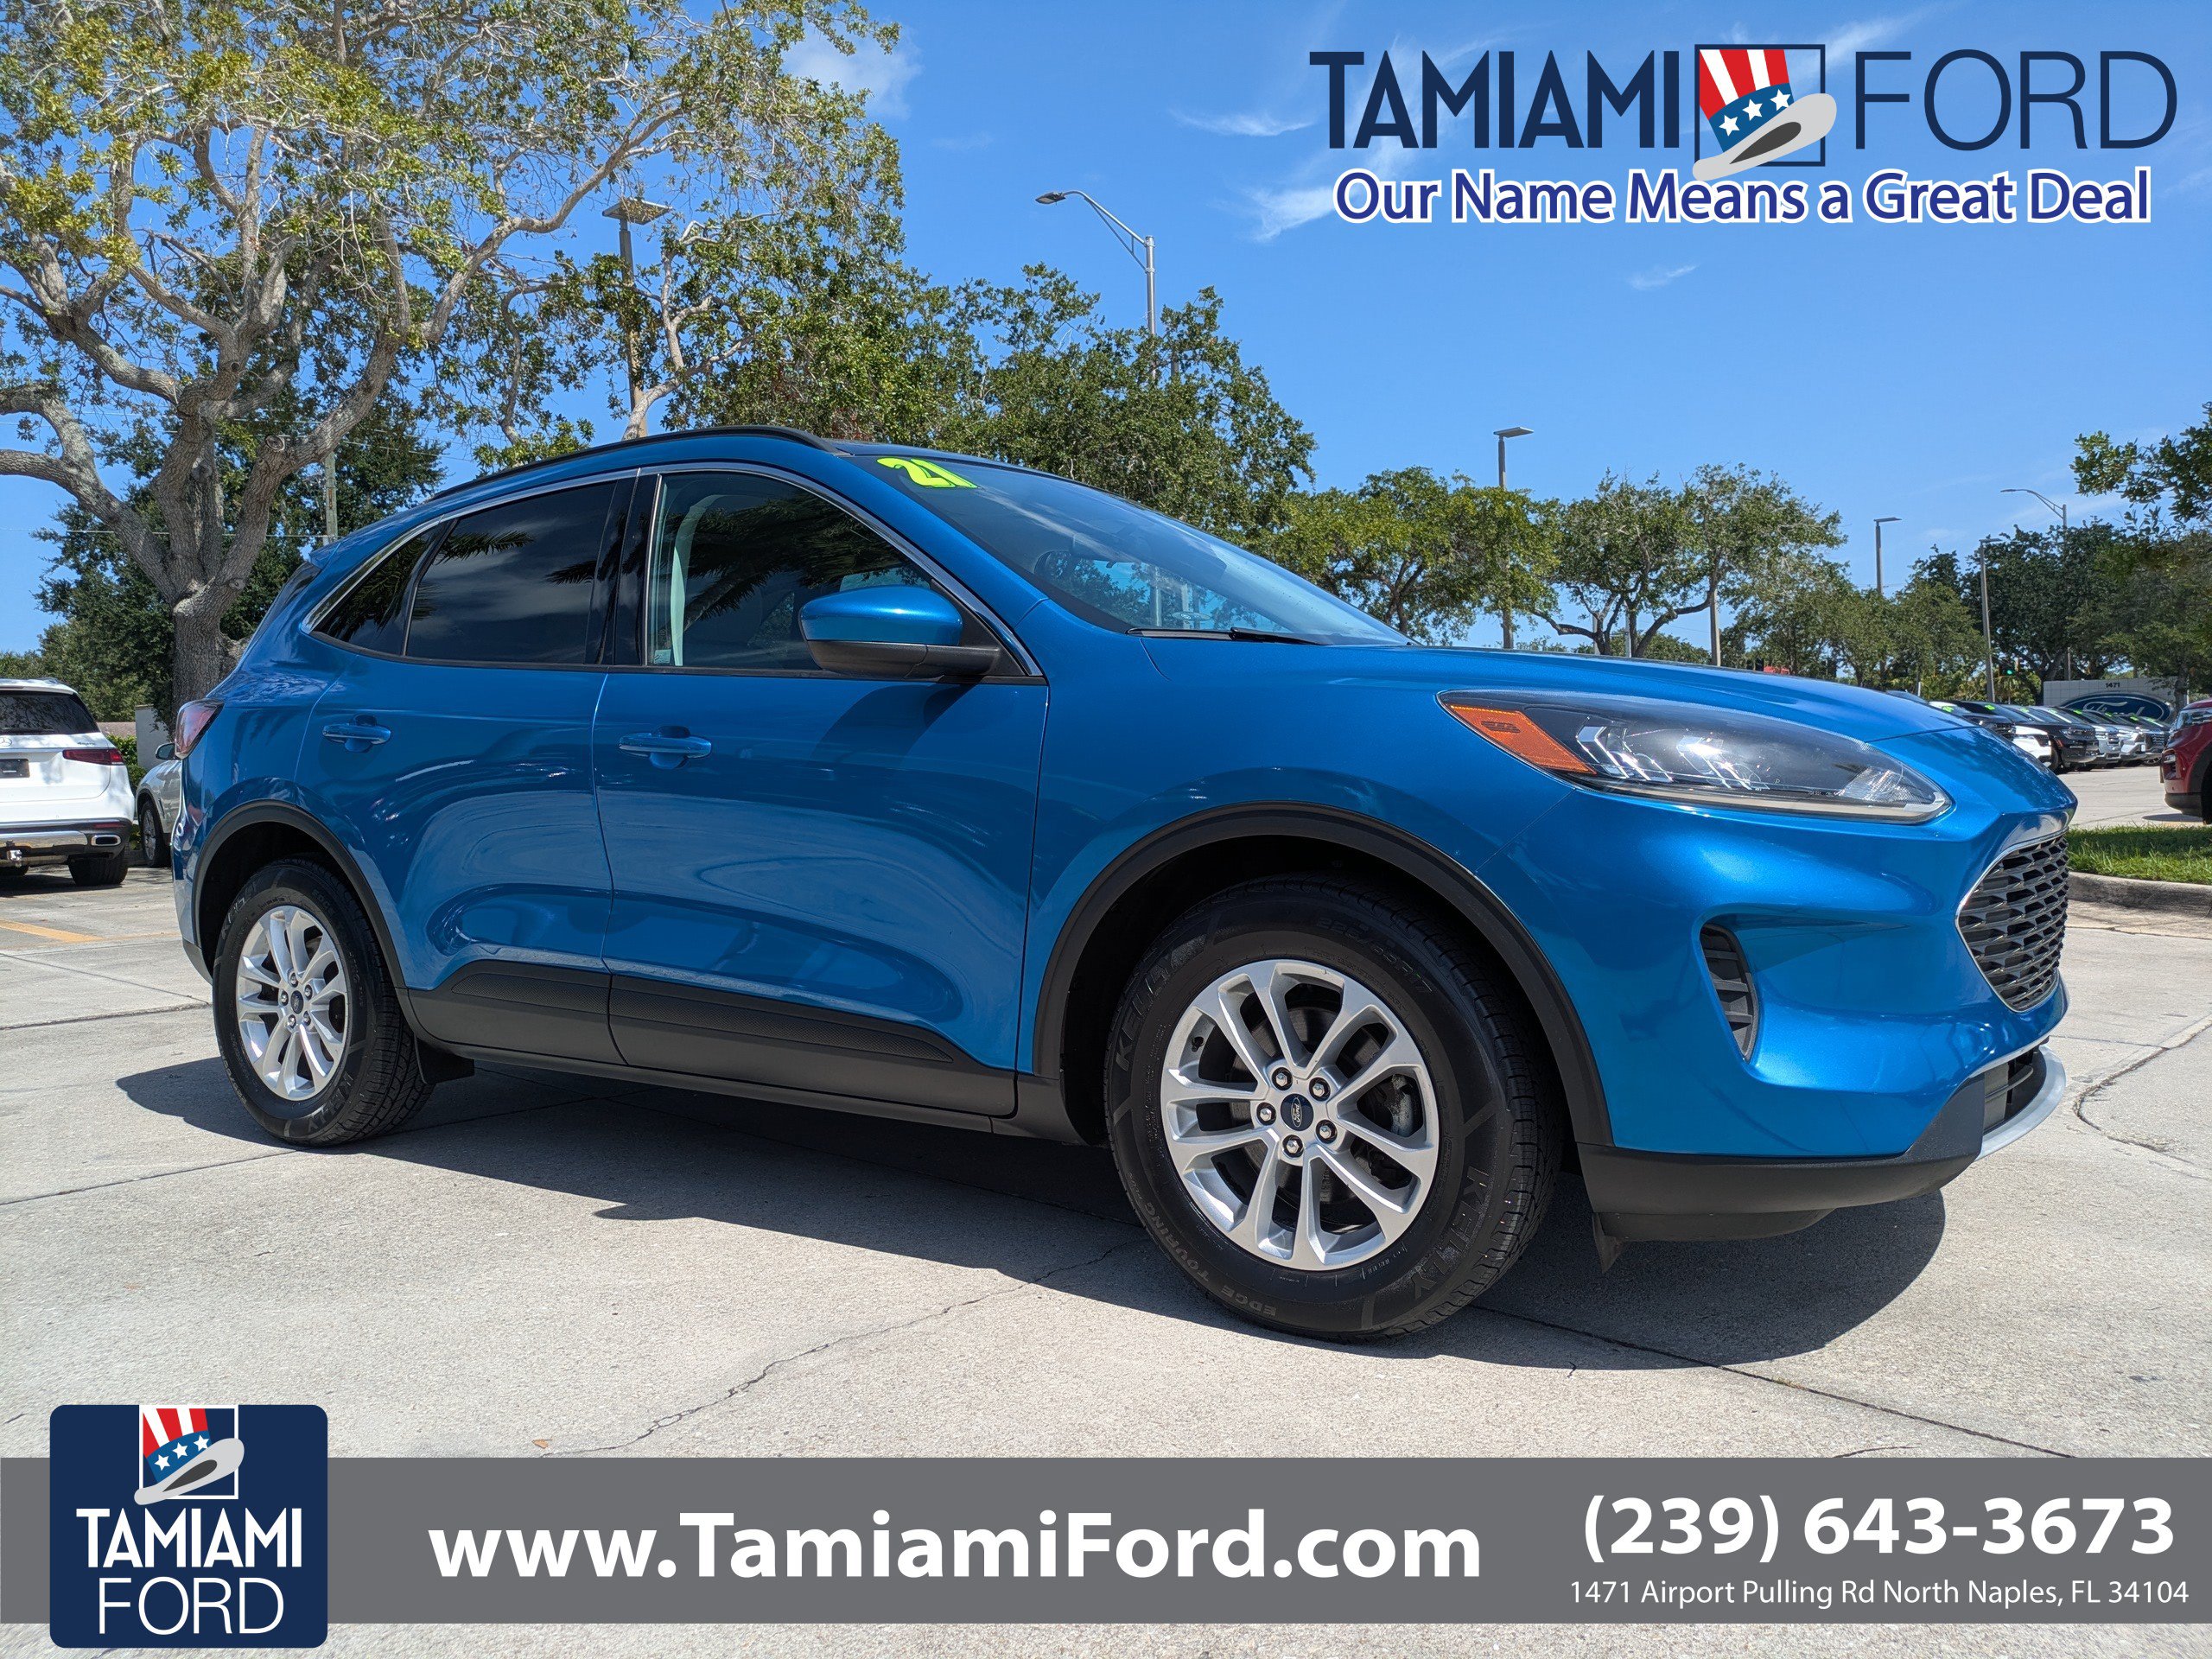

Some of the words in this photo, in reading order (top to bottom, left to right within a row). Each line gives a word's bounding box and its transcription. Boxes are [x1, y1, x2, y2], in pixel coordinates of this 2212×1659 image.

[876, 457, 978, 488] 21
[1144, 1201, 1211, 1283] TOURING
[1410, 1165, 1490, 1300] KELLY
[1220, 1284, 1277, 1318] EDGE
